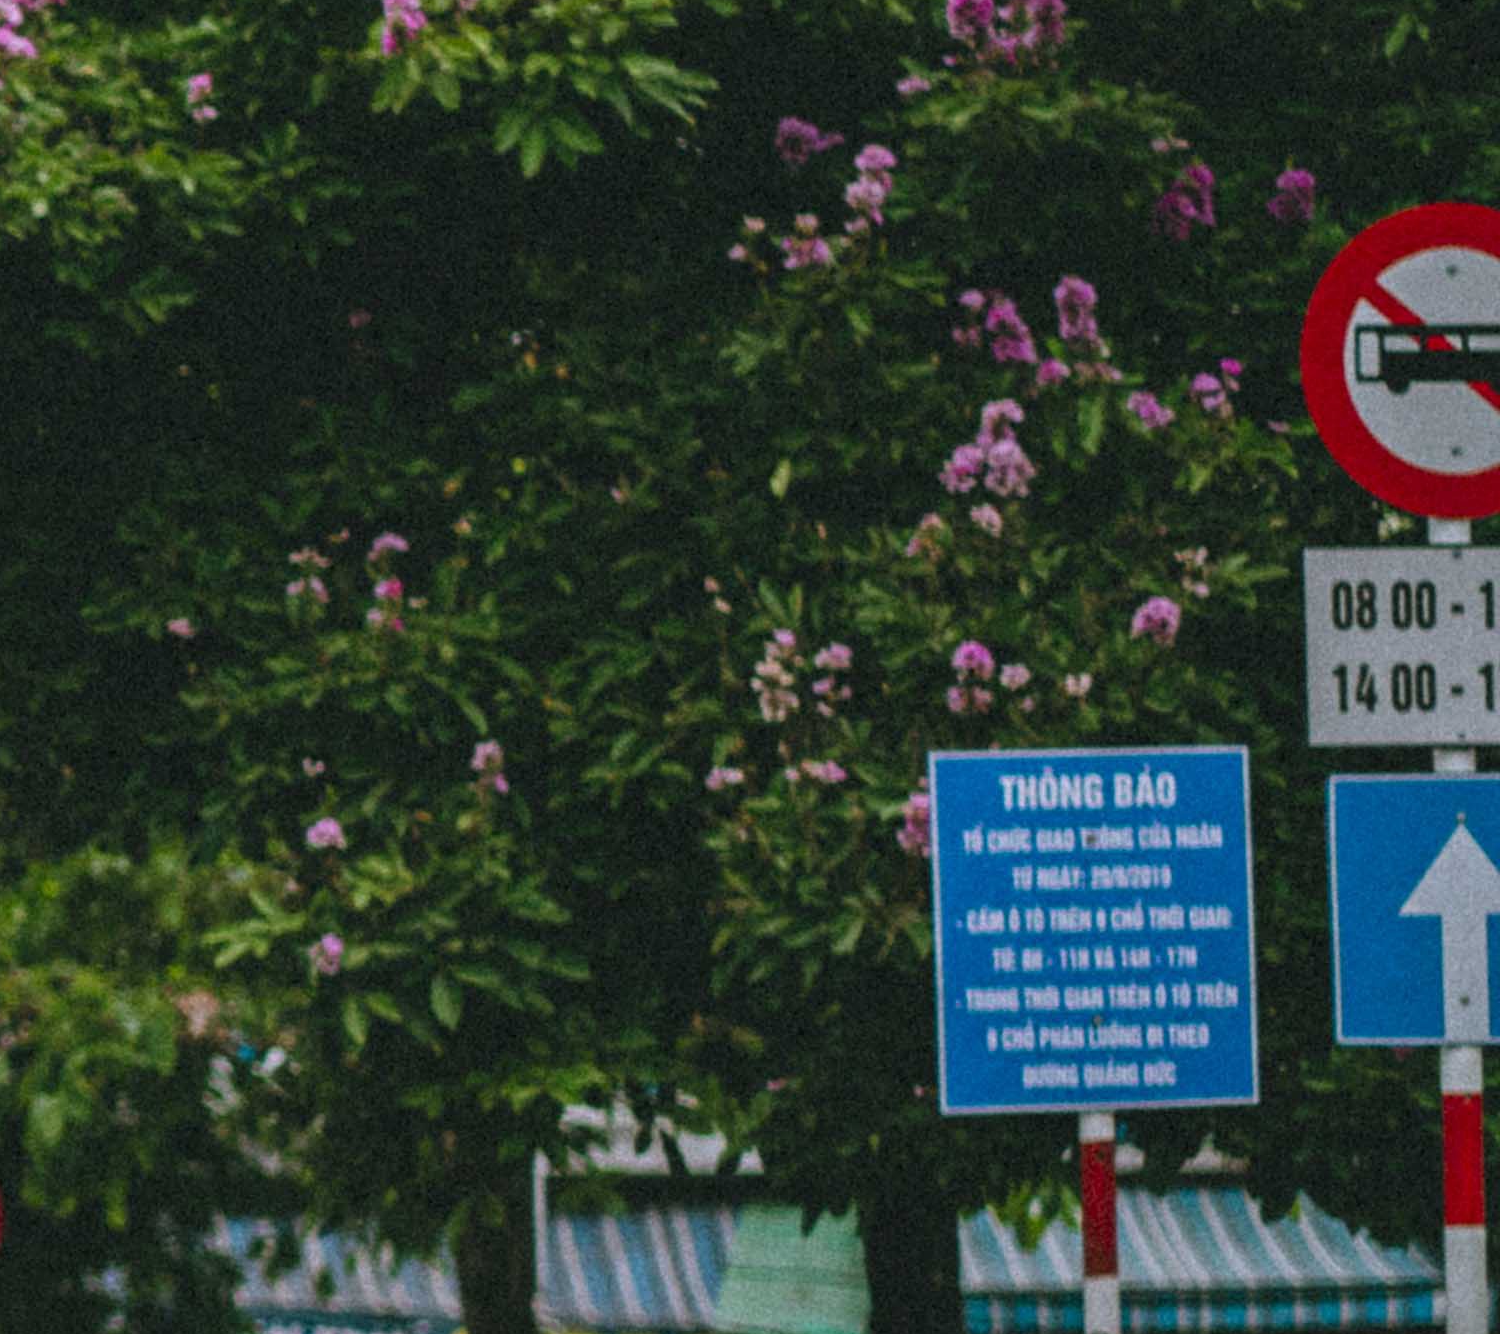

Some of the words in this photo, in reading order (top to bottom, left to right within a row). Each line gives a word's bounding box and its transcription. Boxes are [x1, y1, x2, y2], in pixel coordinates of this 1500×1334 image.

[1332, 580, 1377, 629] 08
[1392, 580, 1436, 629] 00
[1332, 663, 1377, 712] 14
[1392, 662, 1436, 711] 00
[1001, 767, 1103, 809] THÔNG
[1115, 767, 1176, 807] BÁO
[1037, 829, 1075, 851] GIAO
[1065, 988, 1103, 1009] GIAN
